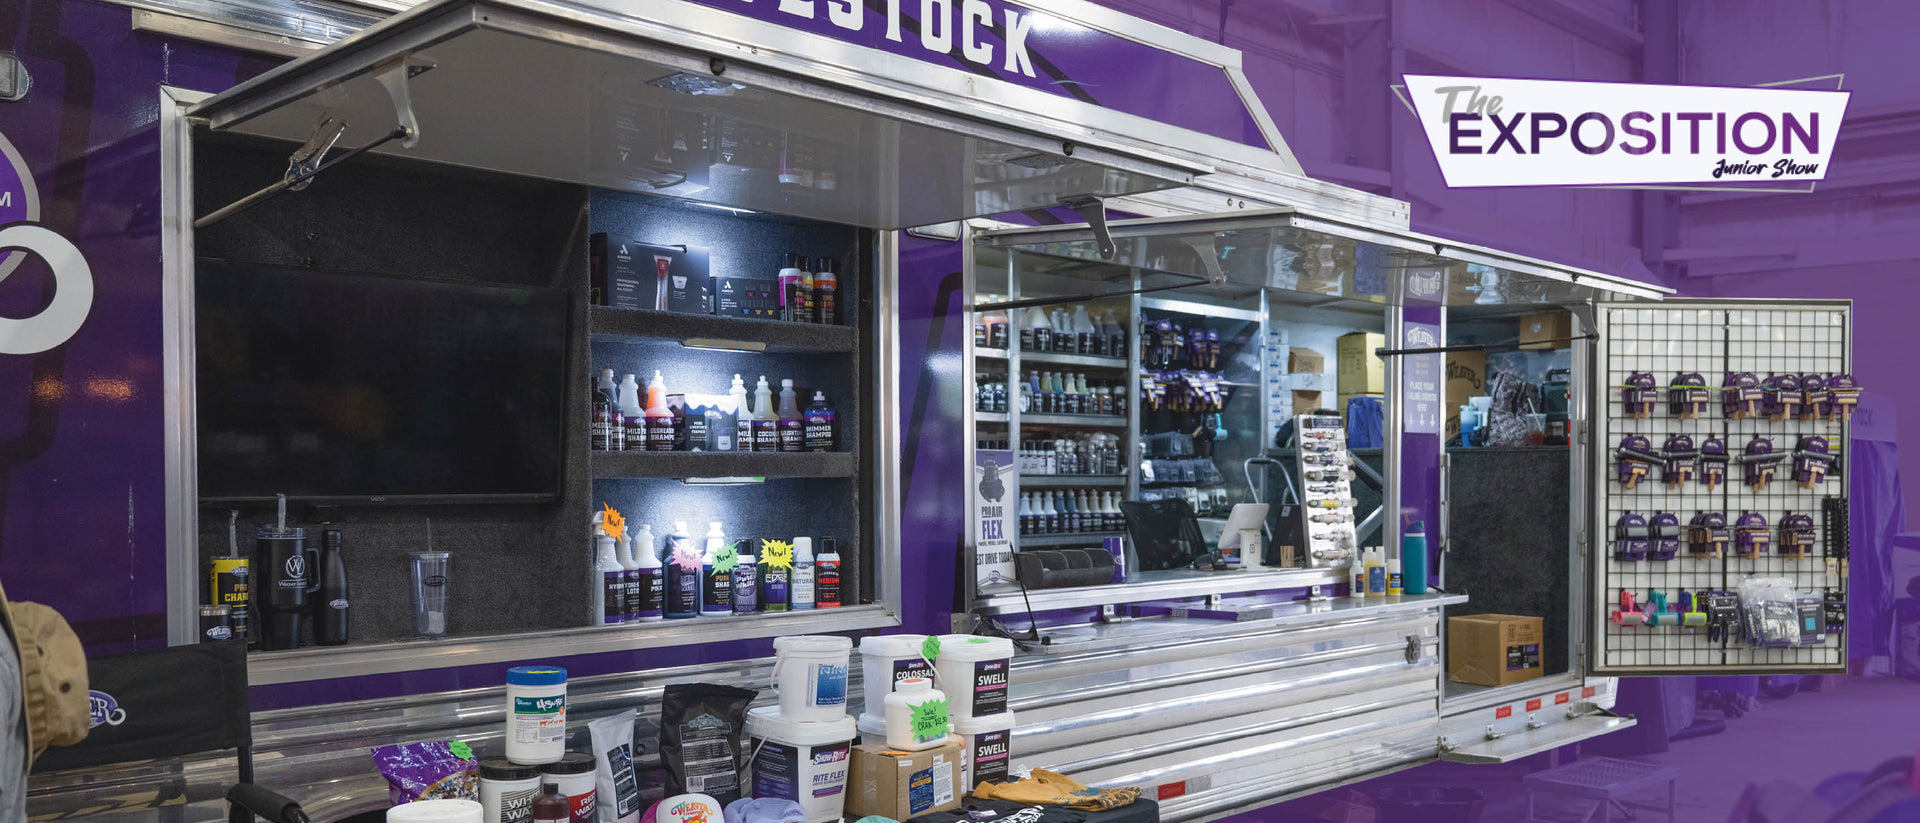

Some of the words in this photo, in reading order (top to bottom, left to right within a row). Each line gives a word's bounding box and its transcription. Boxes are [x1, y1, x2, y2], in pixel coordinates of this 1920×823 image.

[740, 0, 1036, 78] STOCK
[607, 514, 620, 527] New!
[982, 520, 1003, 540] FLEX
[716, 549, 733, 563] New!
[767, 547, 787, 558] New!
[985, 552, 998, 564] DRIVE
[896, 668, 934, 679] COLOSSAL
[978, 672, 1006, 686] SWELL
[923, 706, 936, 715] Sale!
[978, 743, 1007, 756] SWELL
[814, 751, 846, 764] SHOW-RITE
[813, 773, 829, 782] RITE
[830, 770, 845, 779] FLEX
[671, 801, 713, 815] WEAVER
